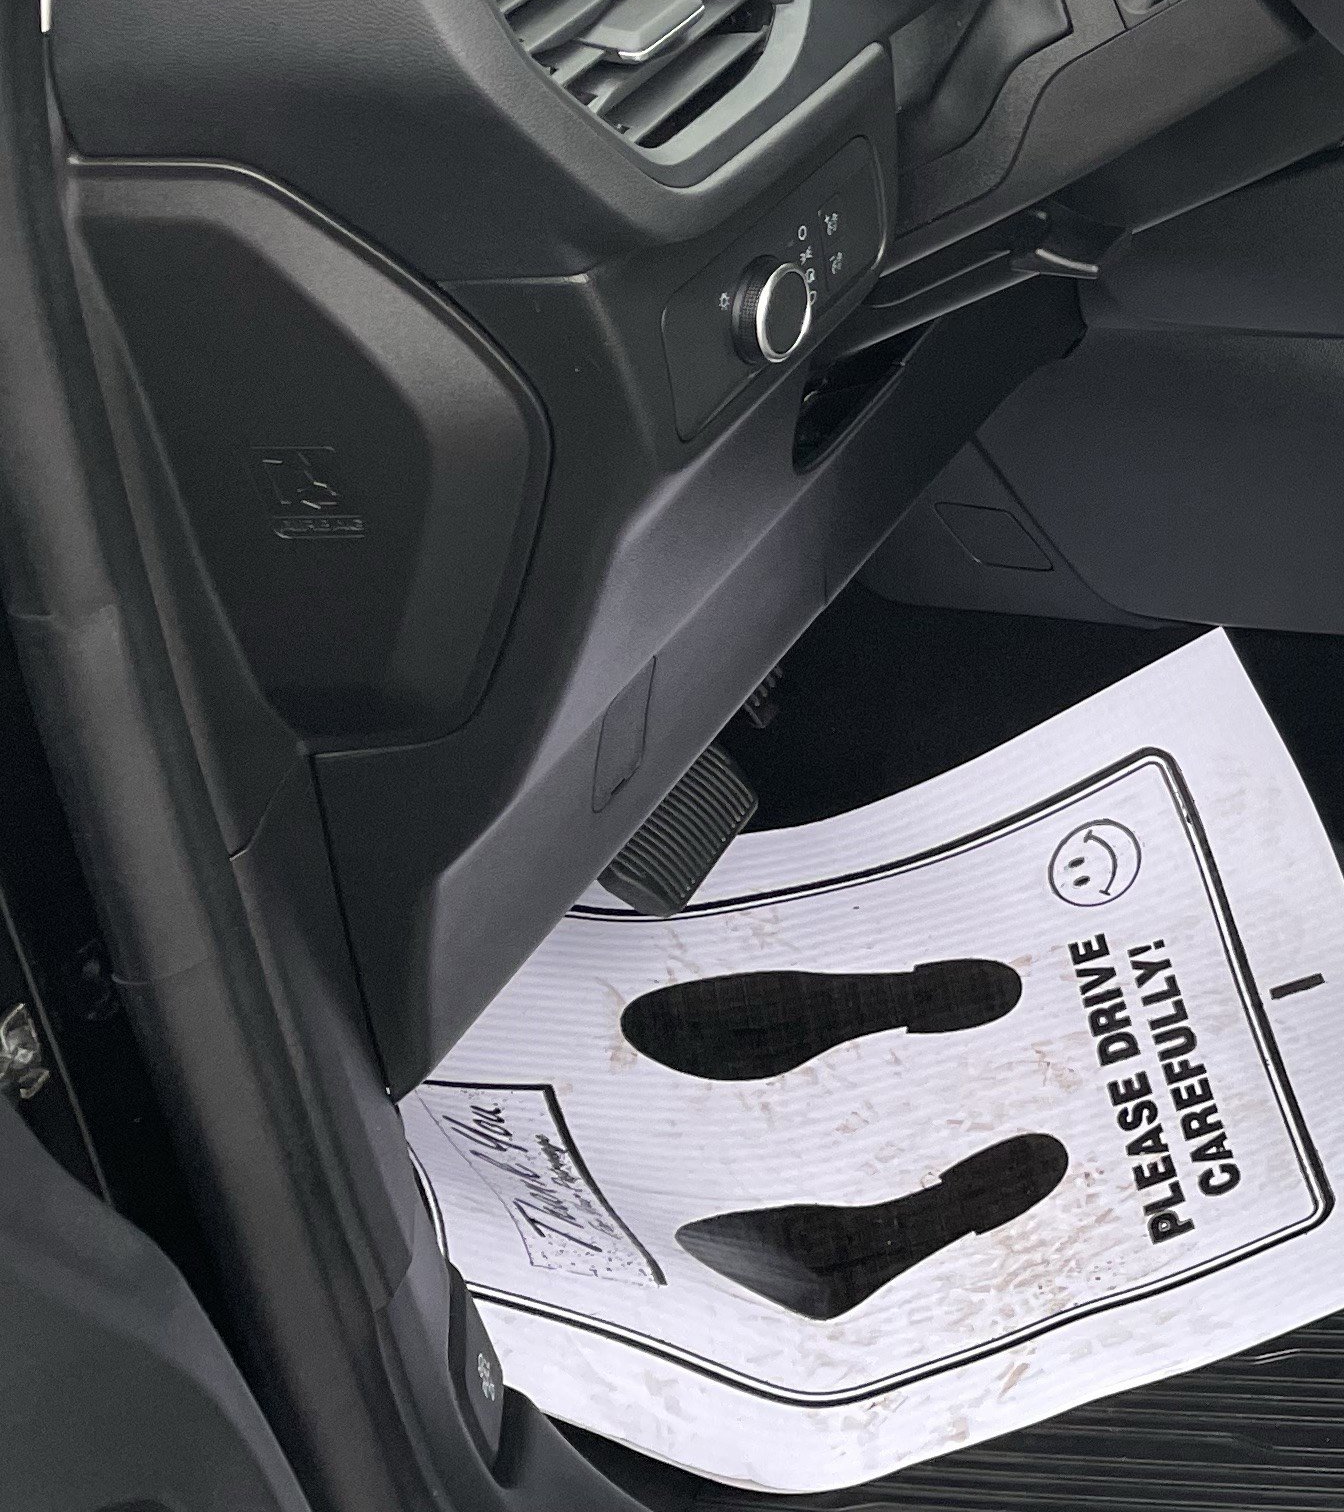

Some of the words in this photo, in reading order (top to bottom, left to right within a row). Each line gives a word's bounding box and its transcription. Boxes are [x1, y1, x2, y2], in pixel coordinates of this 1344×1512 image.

[1068, 933, 1142, 1066] DRIVE
[1127, 938, 1241, 1197] CAREFULLY!
[469, 1149, 602, 1252] Thank
[1106, 1069, 1195, 1245] PLEASE
